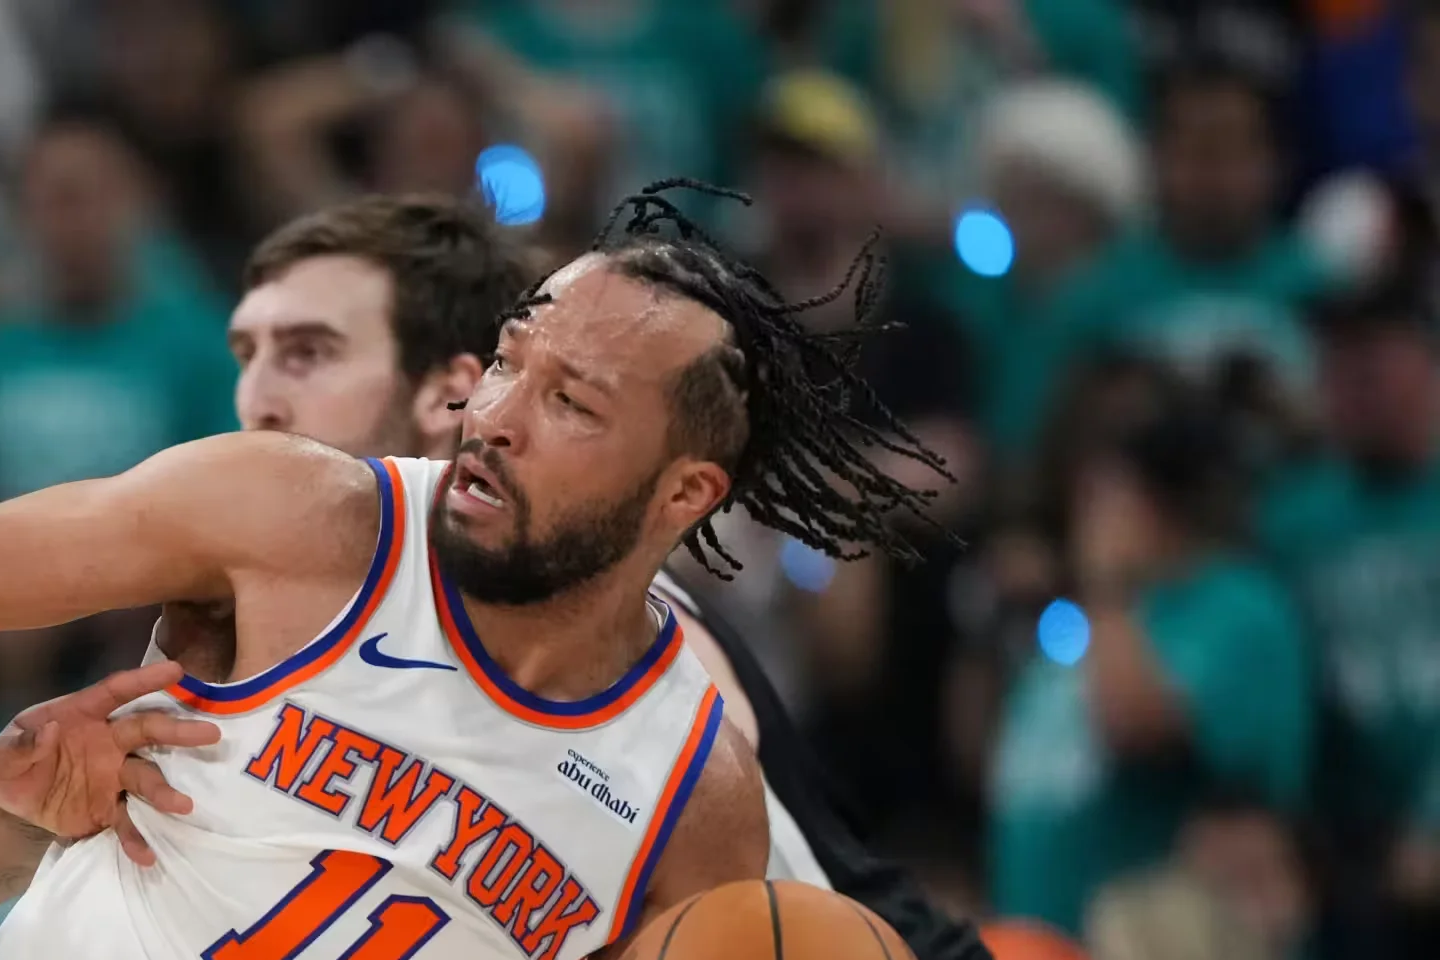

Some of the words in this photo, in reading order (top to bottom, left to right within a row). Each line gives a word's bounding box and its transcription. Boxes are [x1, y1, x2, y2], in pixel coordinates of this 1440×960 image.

[242, 701, 459, 848] NEW
[557, 760, 592, 790] abu
[591, 783, 640, 824] dhabi
[567, 748, 610, 782] experience
